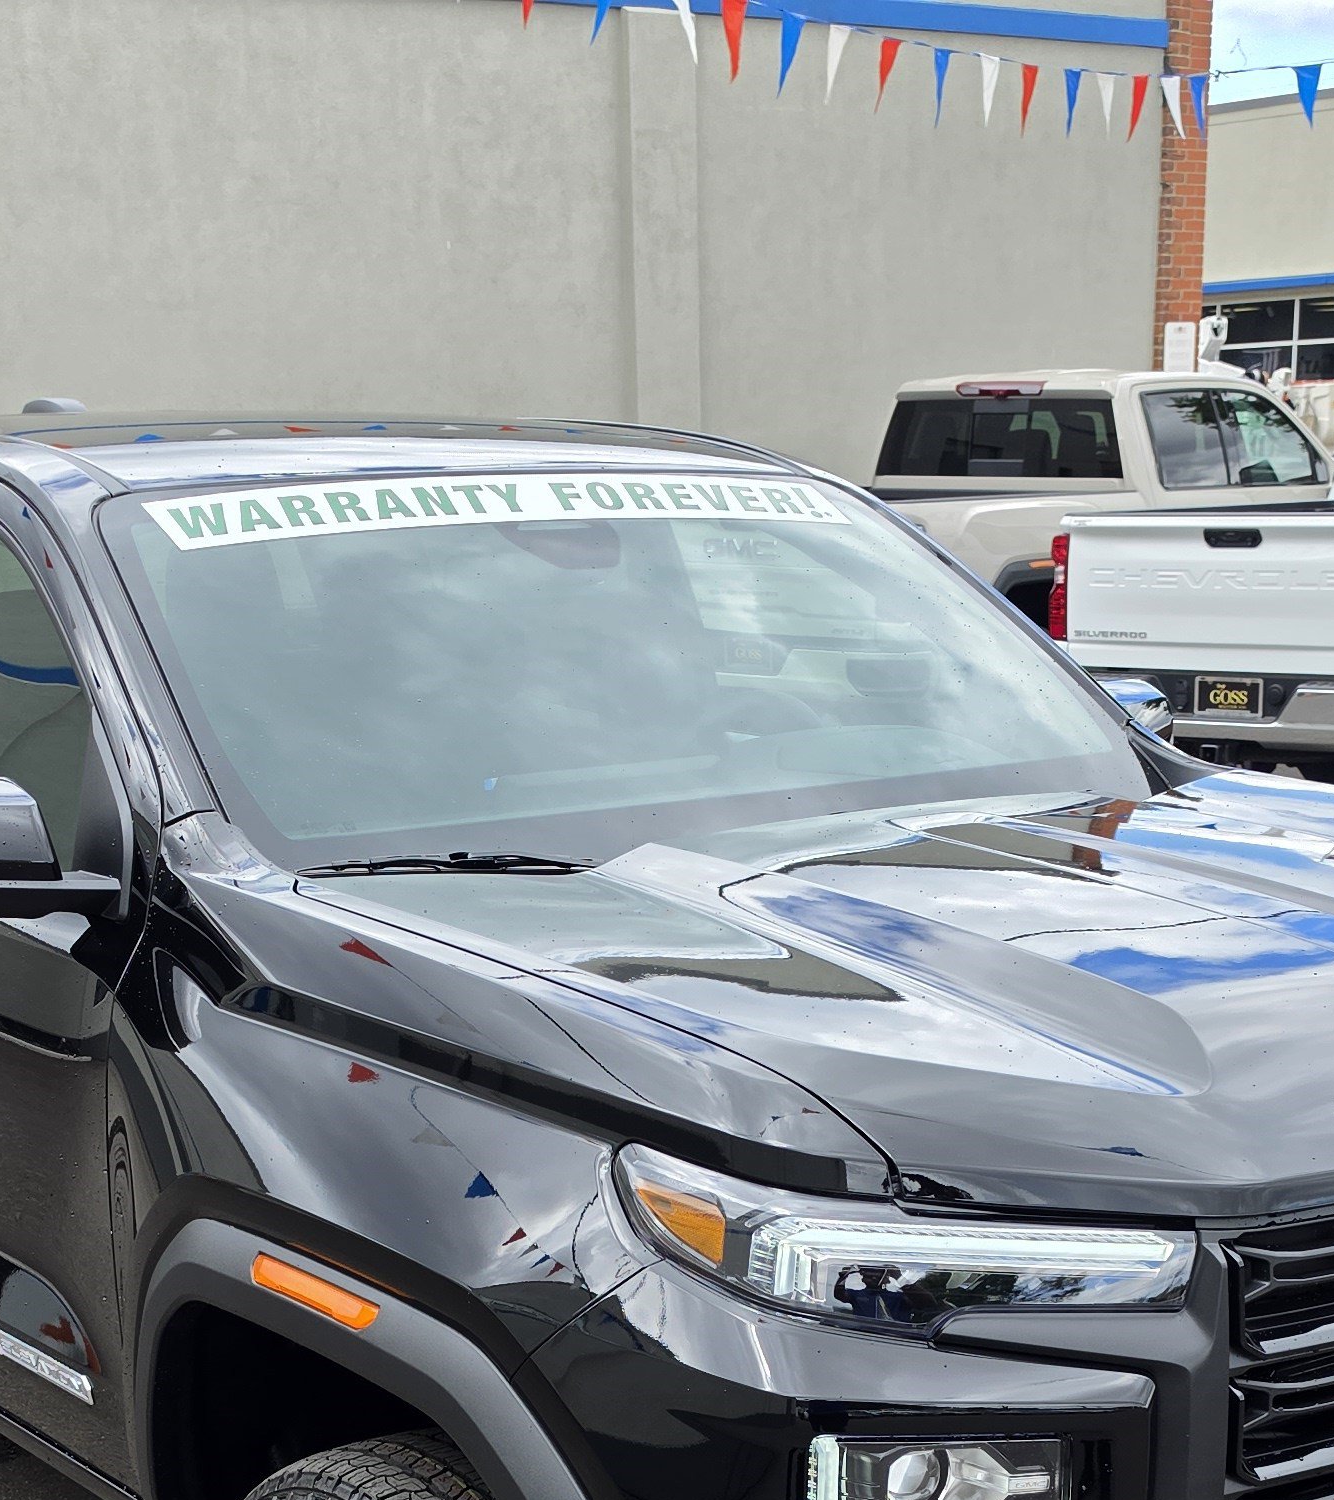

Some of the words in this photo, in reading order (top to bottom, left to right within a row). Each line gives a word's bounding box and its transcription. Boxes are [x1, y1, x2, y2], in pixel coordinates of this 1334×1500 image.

[169, 482, 522, 540] WARRANTY
[547, 482, 824, 519] FOREVER!
[1074, 629, 1147, 640] SILVERADO
[1210, 689, 1248, 705] GOSS
